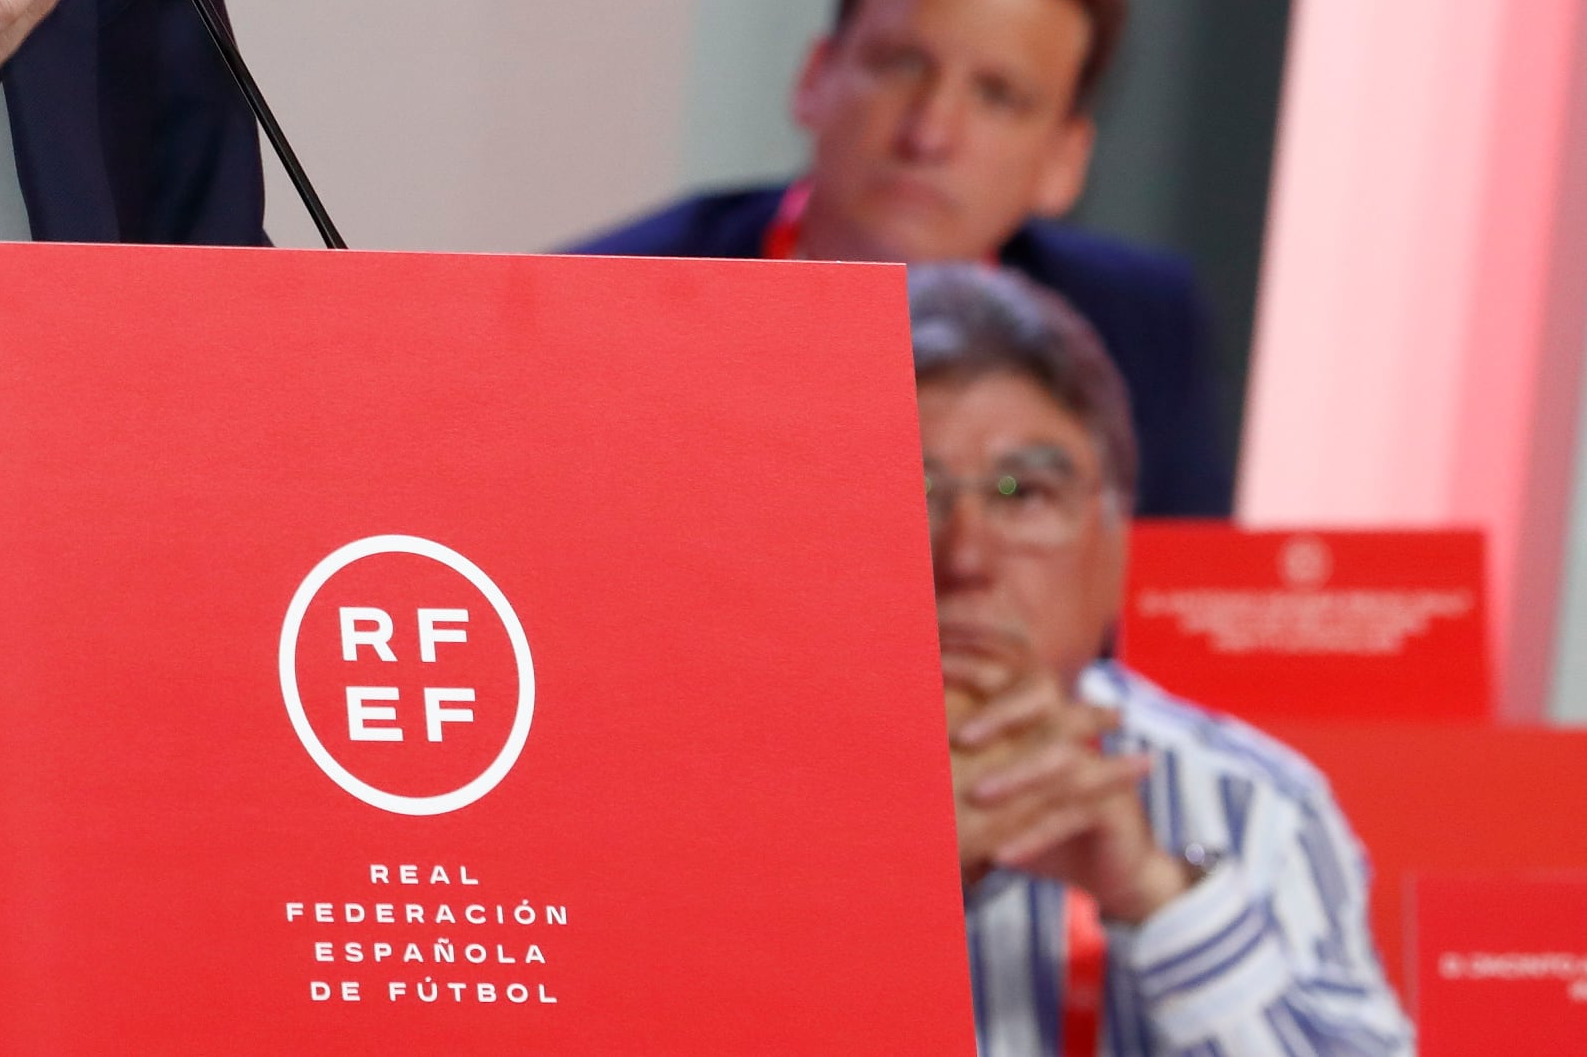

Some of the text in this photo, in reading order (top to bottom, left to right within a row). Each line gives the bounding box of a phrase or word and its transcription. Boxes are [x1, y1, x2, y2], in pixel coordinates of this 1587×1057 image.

[339, 607, 469, 662] RF
[346, 686, 475, 741] EF
[370, 865, 478, 884] REAL
[286, 900, 567, 924] FEDERACIÓN
[315, 939, 545, 963] ESPAÑOLA
[311, 977, 557, 1003] DE FÚTBOL
